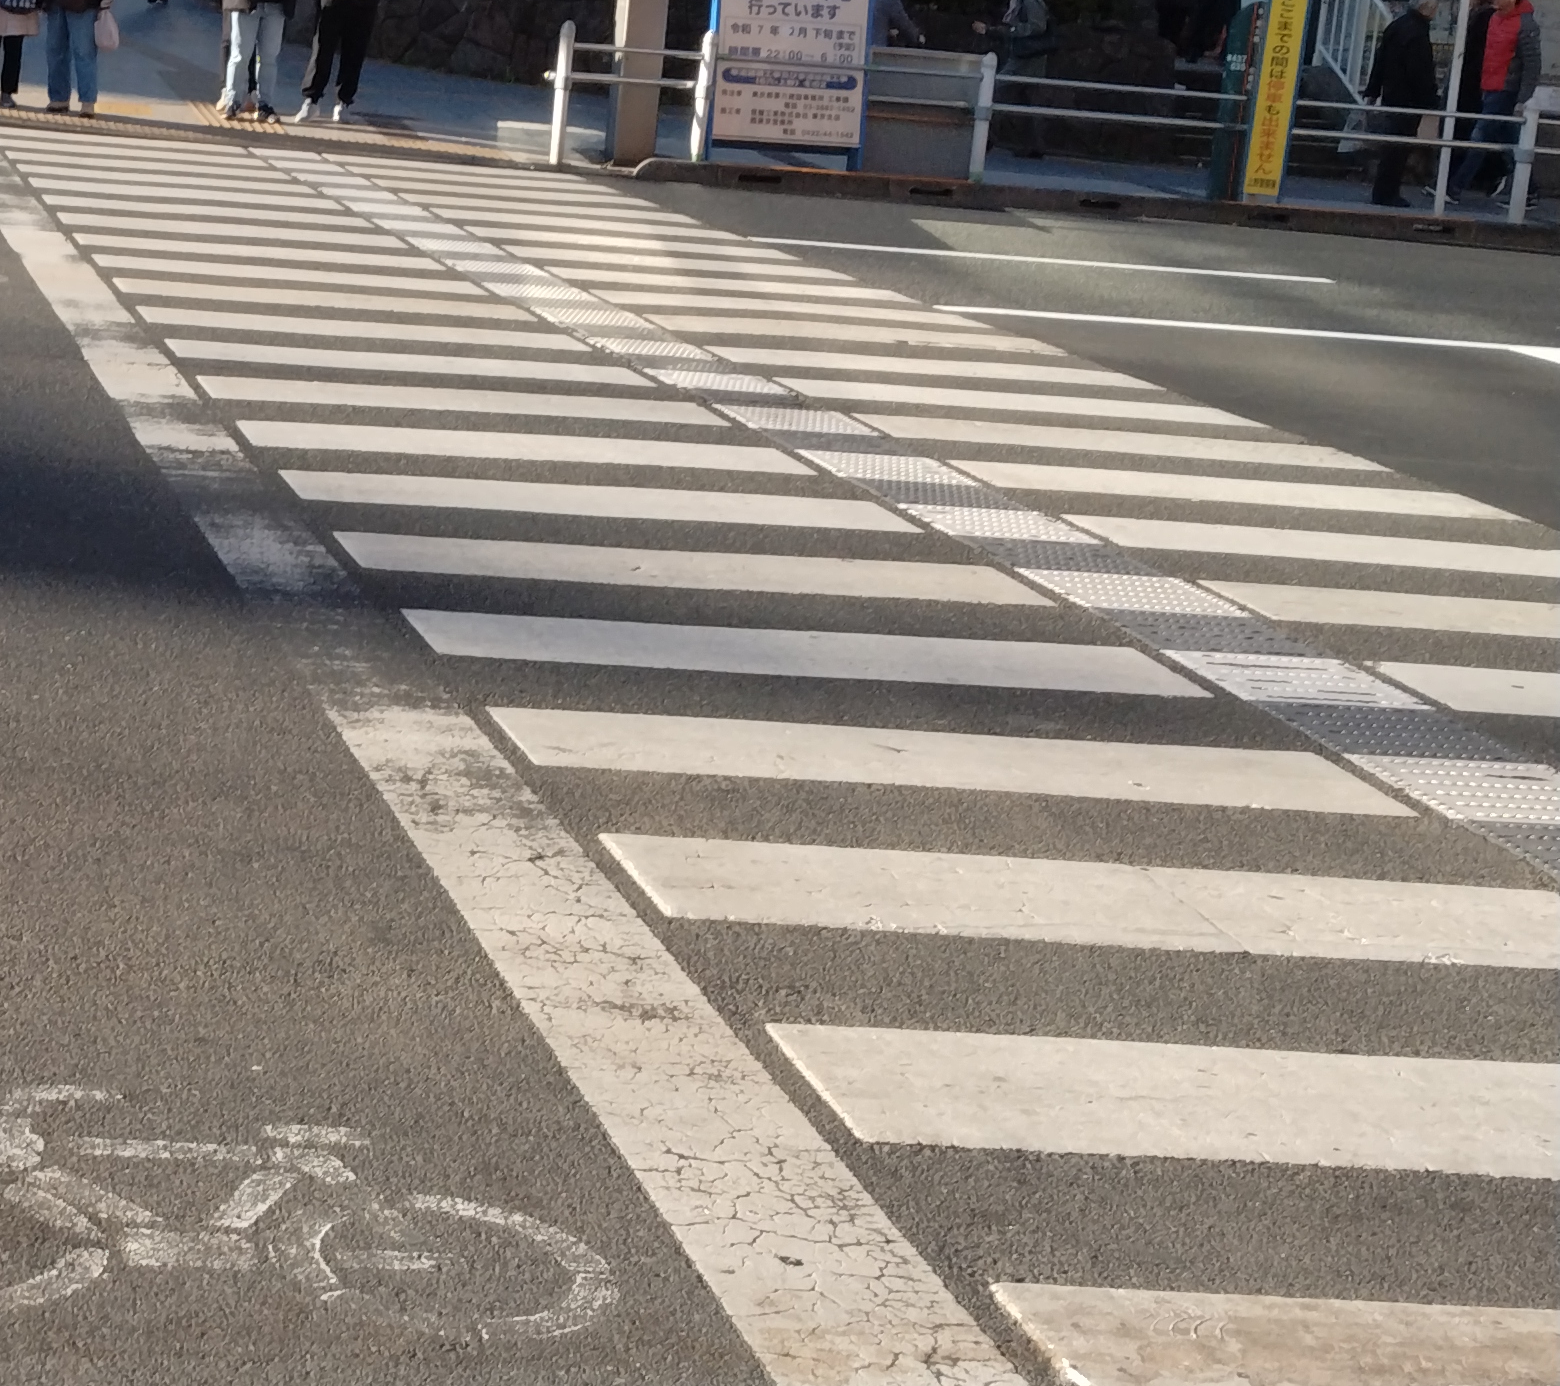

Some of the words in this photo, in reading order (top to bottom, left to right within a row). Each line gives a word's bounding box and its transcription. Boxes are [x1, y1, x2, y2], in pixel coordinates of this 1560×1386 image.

[748, 0, 840, 20] 行っています
